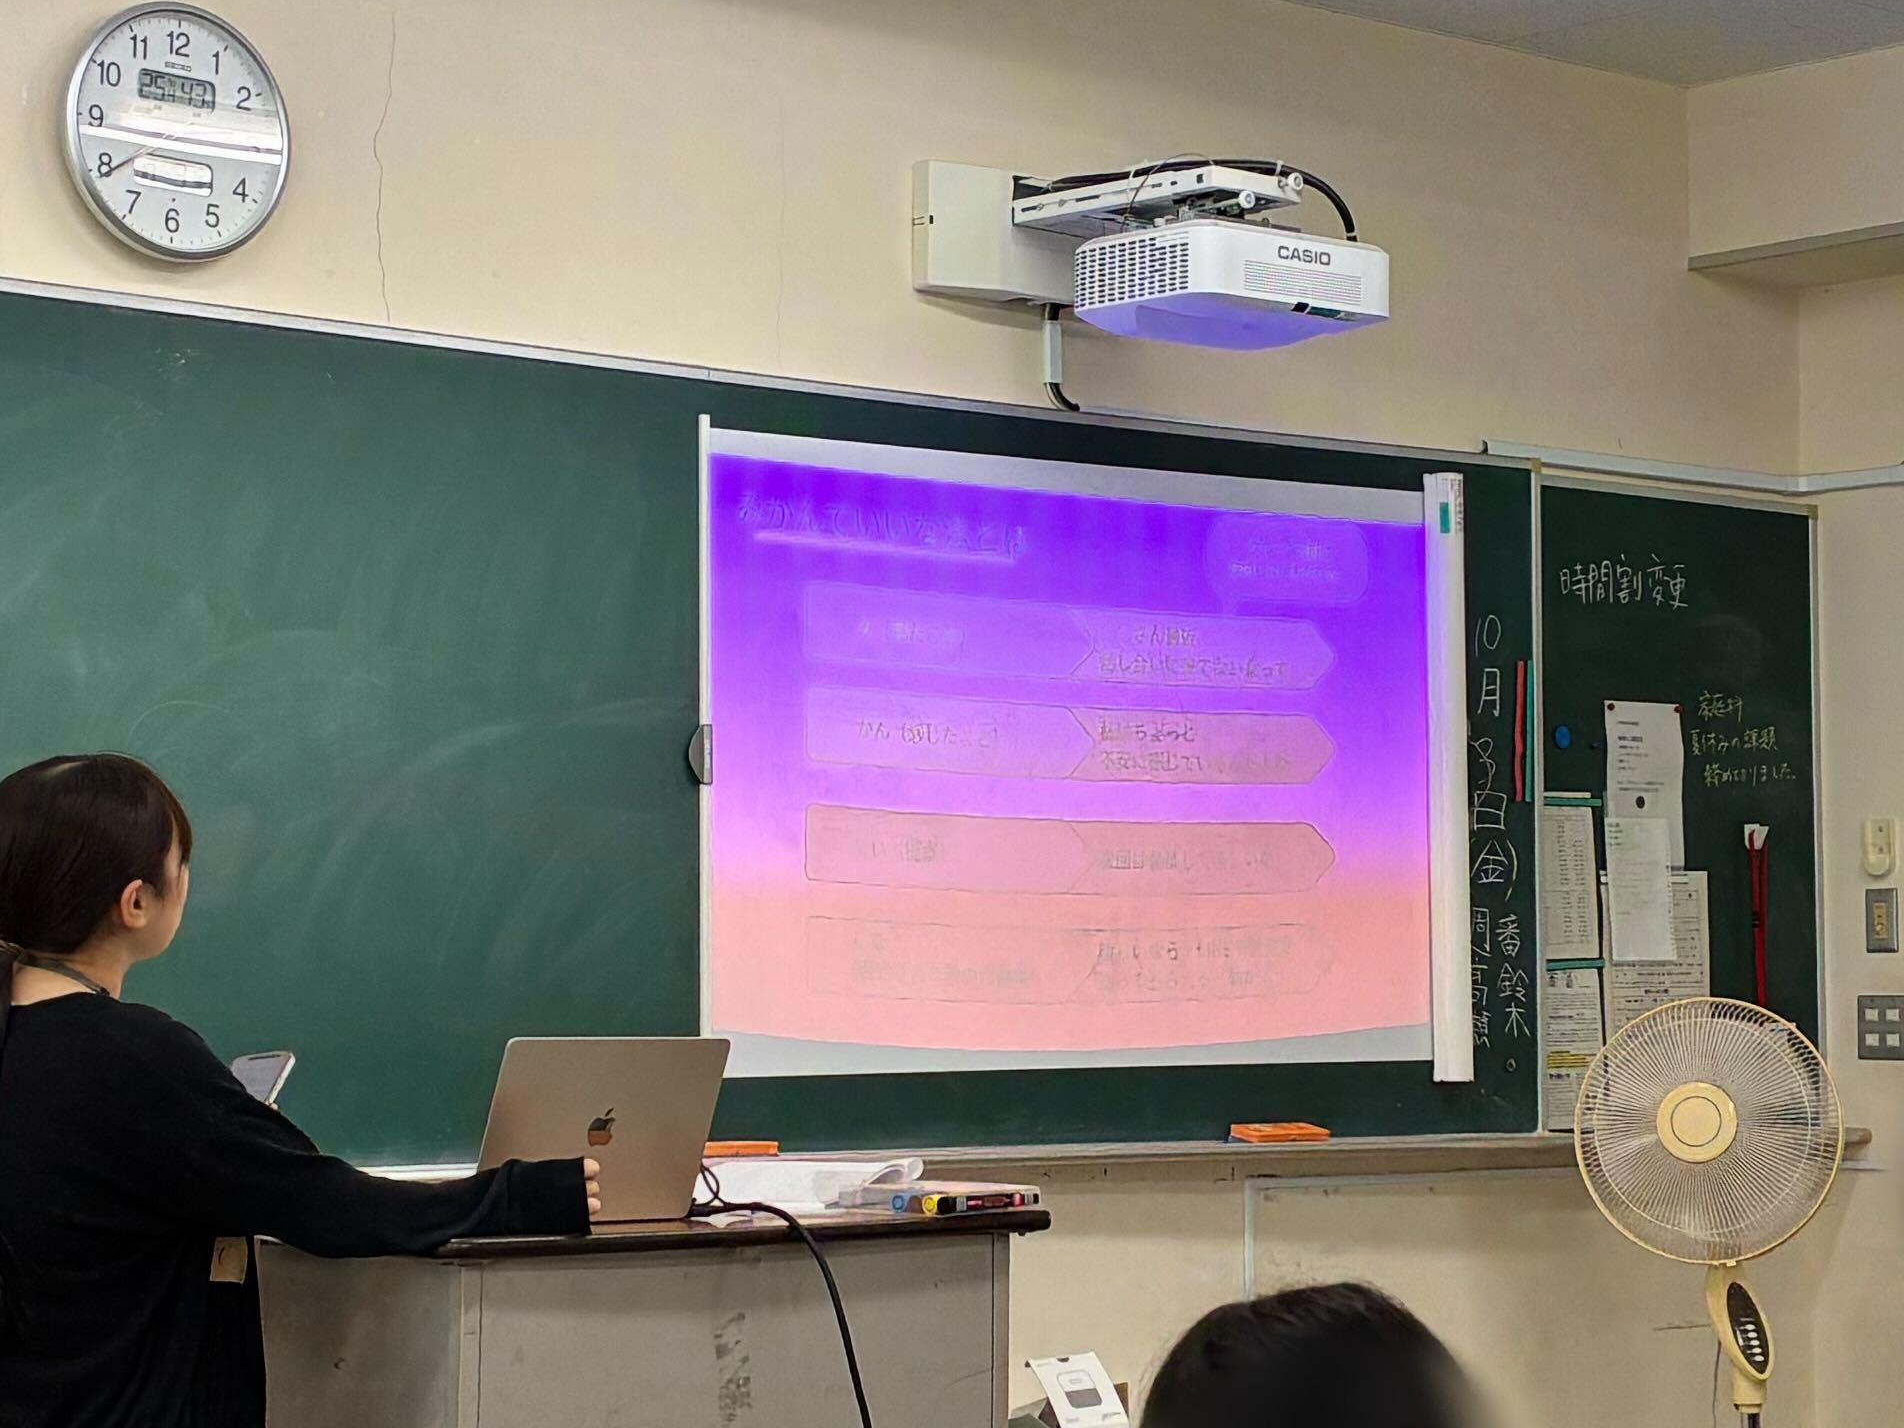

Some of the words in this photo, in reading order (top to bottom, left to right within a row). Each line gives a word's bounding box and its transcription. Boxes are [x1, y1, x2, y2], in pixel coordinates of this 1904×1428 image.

[129, 34, 149, 61] 11
[166, 30, 191, 58] 12
[96, 60, 122, 88] 10
[211, 50, 221, 76] 1
[236, 86, 252, 111] 2
[88, 104, 105, 128] 9
[96, 152, 113, 178] 8
[125, 189, 142, 215] 7
[231, 177, 249, 204] 4
[164, 208, 180, 233] 6
[204, 203, 220, 229] 5
[1277, 244, 1332, 267] CASIO
[1559, 553, 1689, 610] 時間割変更
